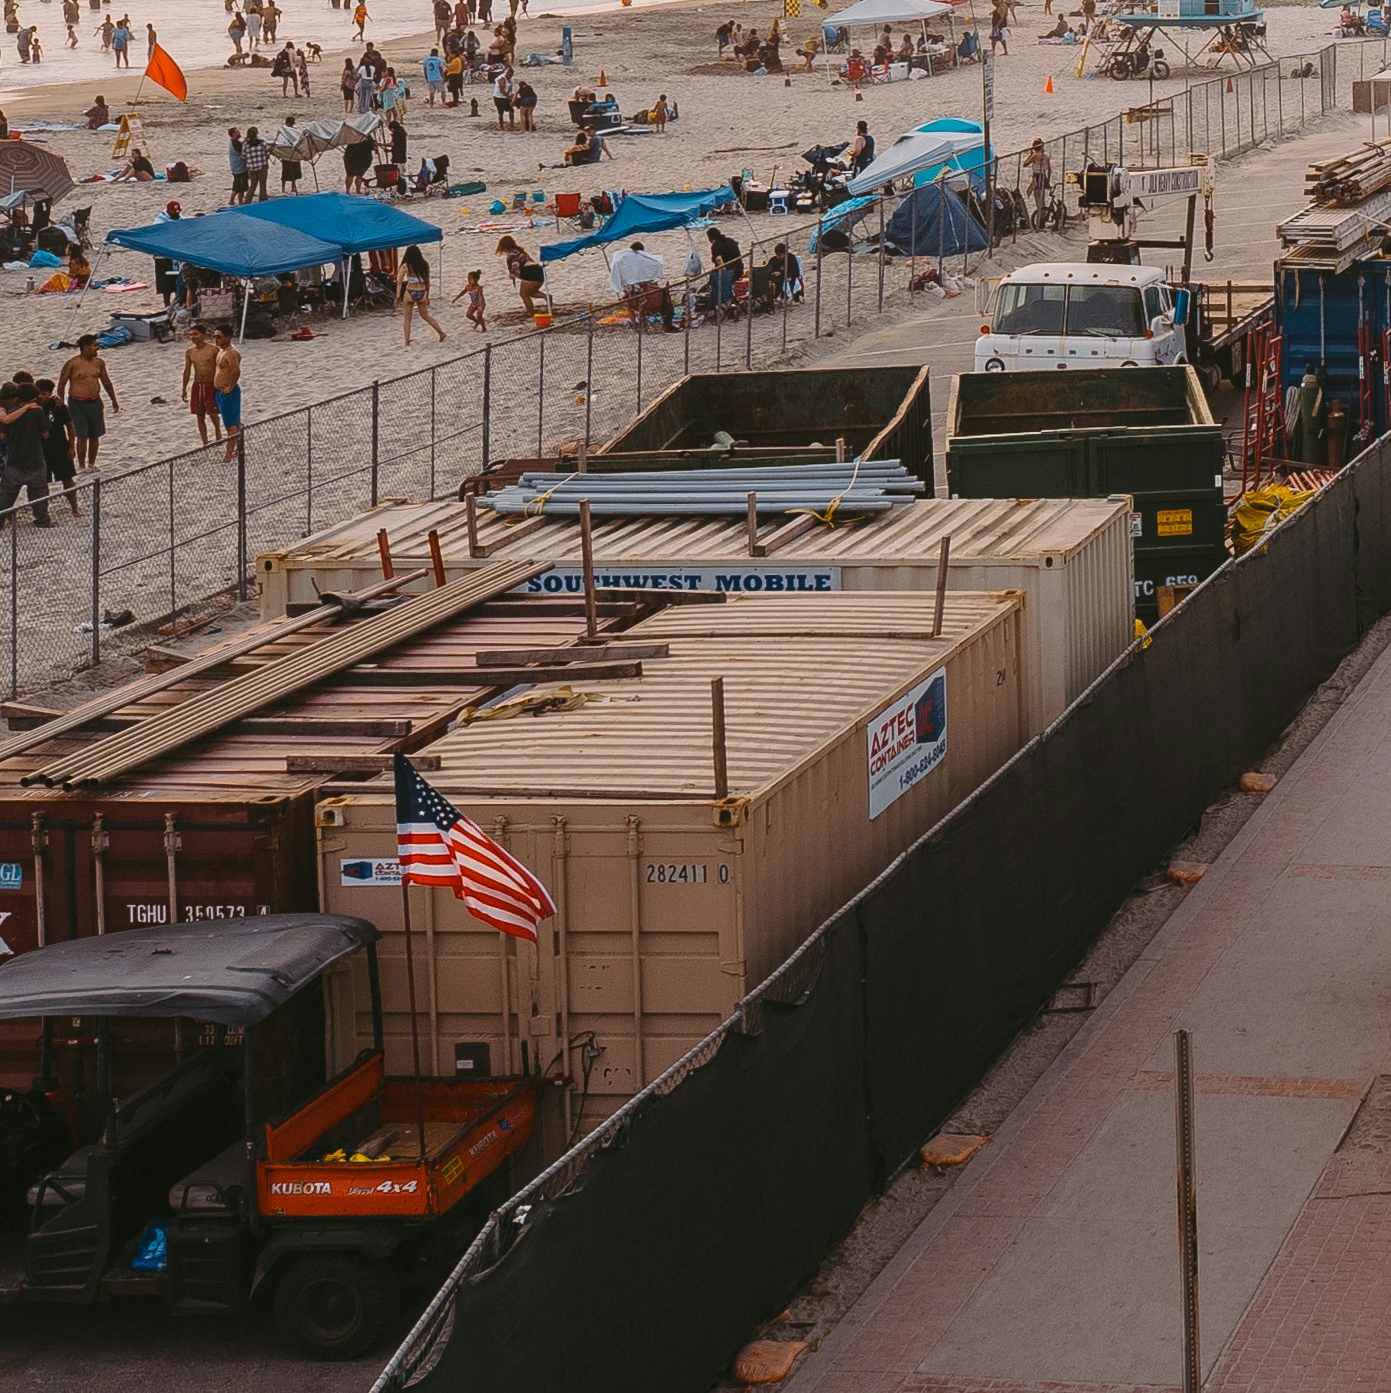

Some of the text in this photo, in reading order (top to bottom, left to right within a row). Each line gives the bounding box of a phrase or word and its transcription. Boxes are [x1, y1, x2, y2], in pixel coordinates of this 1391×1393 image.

[715, 574, 831, 592] MOBILE
[870, 703, 914, 759] AZTEC
[870, 730, 915, 776] CONTAINER
[647, 864, 729, 883] 282411 0
[127, 904, 167, 924] TGHU
[271, 1181, 332, 1195] KUBOTA
[376, 1180, 418, 1194] 4x4
